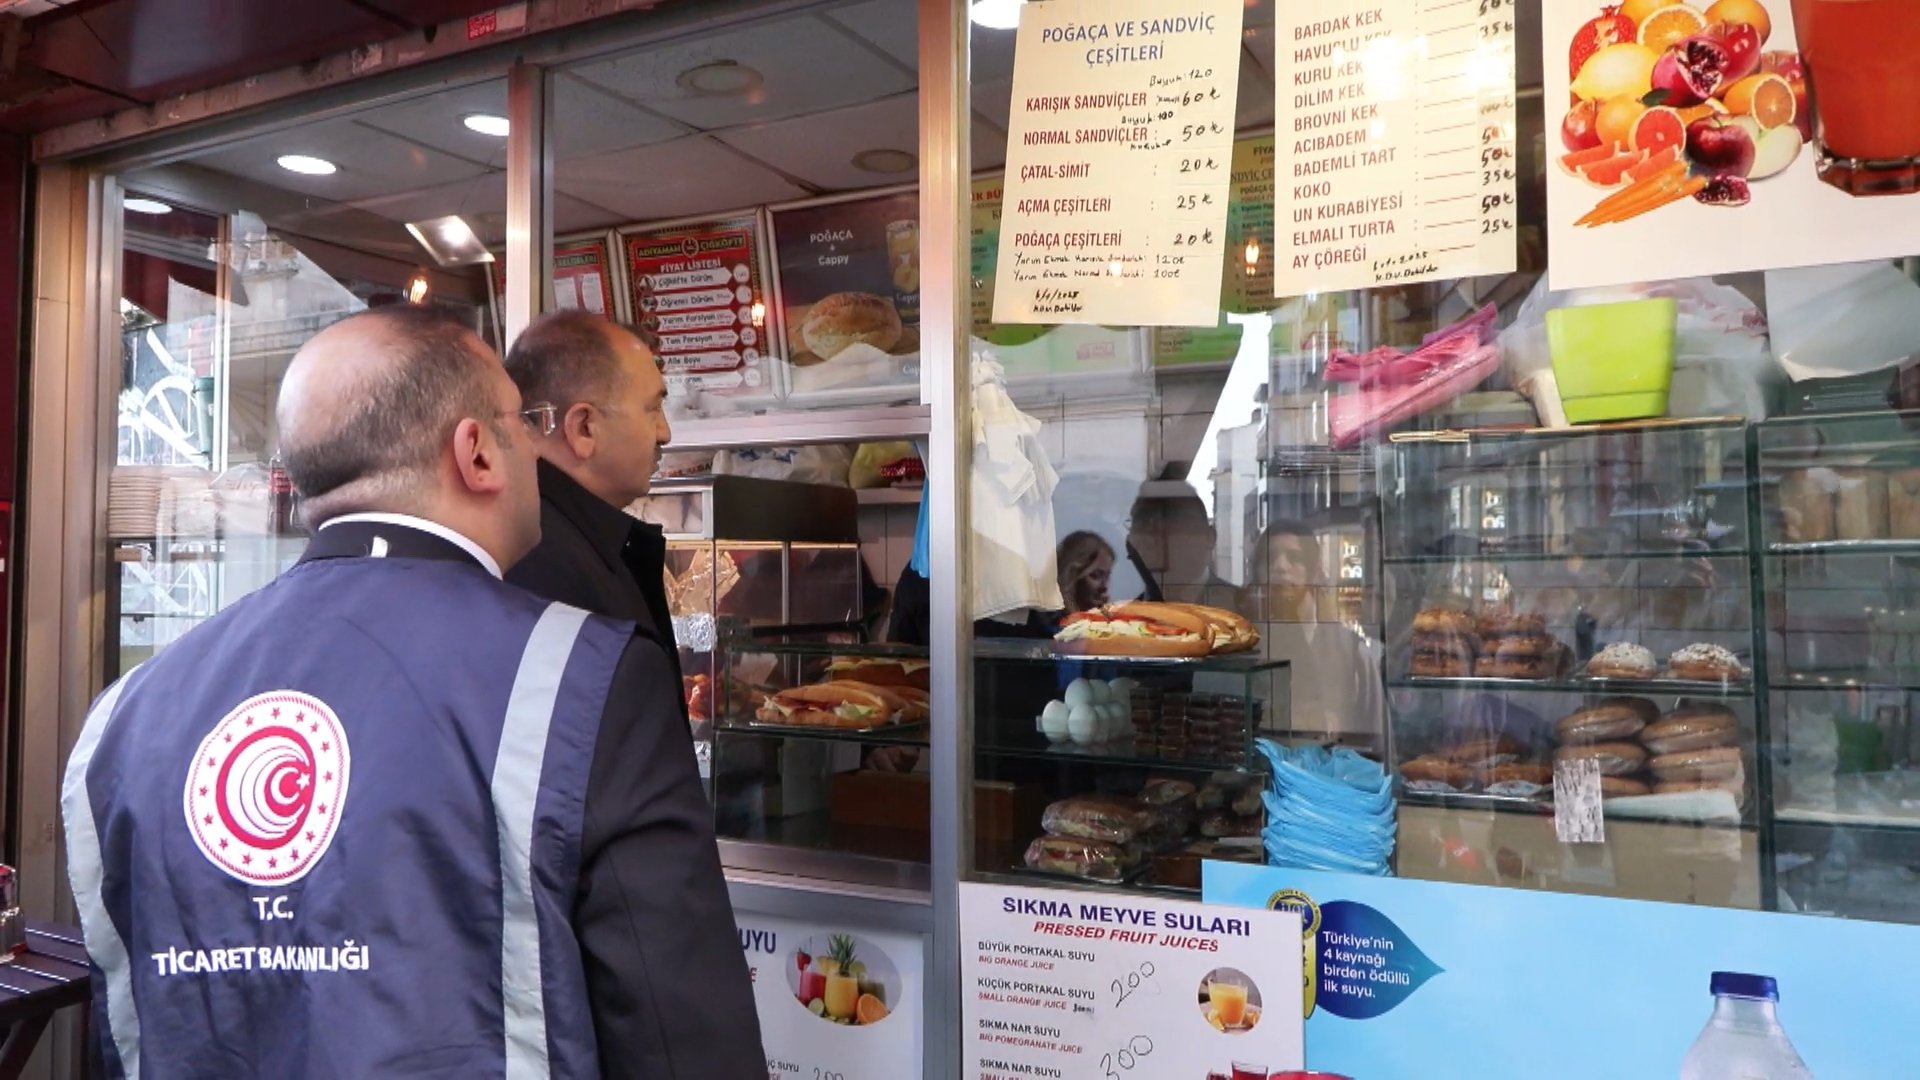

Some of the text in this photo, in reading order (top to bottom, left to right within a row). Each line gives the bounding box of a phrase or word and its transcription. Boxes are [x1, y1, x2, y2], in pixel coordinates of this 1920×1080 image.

[1043, 11, 1215, 44] POĞAÇA VE SANDVİÇ
[1294, 15, 1351, 41] BARDAK
[1355, 8, 1383, 28] KEK
[1086, 40, 1164, 68] ÇEŞİTLERİ
[1294, 59, 1364, 86] KURU KEK
[1026, 96, 1071, 114] KARIŞIK
[1074, 91, 1147, 111] SANDVİÇLER
[1294, 82, 1366, 109] DİLİM KEK
[1294, 103, 1379, 132] BROVNİ KEK
[1023, 130, 1071, 146] NORMAL
[1075, 125, 1148, 145] SANDVİÇLER
[1293, 129, 1367, 155] ACIBADEM
[1021, 160, 1091, 183] ÇATAL-SİMİT
[1294, 146, 1397, 177] BADEMLİ TART
[1293, 181, 1331, 201] KOKO
[1017, 195, 1112, 216] AÇMA ÇEŞİTLERİ
[1293, 190, 1403, 223] UN KURABİYESİ
[810, 229, 854, 244] POĞAÇA
[1014, 228, 1122, 250] POĞAÇA ÇEŞİTLERİ
[1293, 219, 1395, 247] ELMALI TURTA
[660, 261, 685, 274] FİYAT
[818, 254, 849, 266] Cappy
[1292, 243, 1367, 270] AY ÇÖREĞİ
[252, 896, 294, 920] T.C.
[1003, 897, 1073, 919] SIKMA
[1080, 904, 1157, 928] MEYVE
[1164, 912, 1251, 937] SULARI
[1033, 921, 1219, 953] PRESSED FRUIT JUICES
[151, 939, 370, 976] TİCARET BAKANLIĞI
[978, 940, 1096, 962] BÜYÜK PORTAKAL SUYU
[1323, 948, 1386, 968] 4 kaynağı
[978, 955, 1055, 971] BIG ORANGE JUICE
[1323, 963, 1366, 980] birden
[1369, 968, 1410, 986] ödüllü
[977, 976, 1096, 1000] KÜÇÜK PORTAKAL SUYU
[1111, 960, 1156, 1008] 200
[1323, 979, 1376, 998] ilk suyu.
[978, 991, 1067, 1010] SMALL ORANGE JUICE
[979, 1019, 1061, 1039] SIKMA NAR SUYU
[979, 1032, 1083, 1054] BIG POMEGRANATE JUICE
[777, 1061, 800, 1073] SUYU
[979, 1058, 1010, 1071] SIKMA
[1011, 1063, 1032, 1075] NAR
[1034, 1066, 1062, 1079] SUYU
